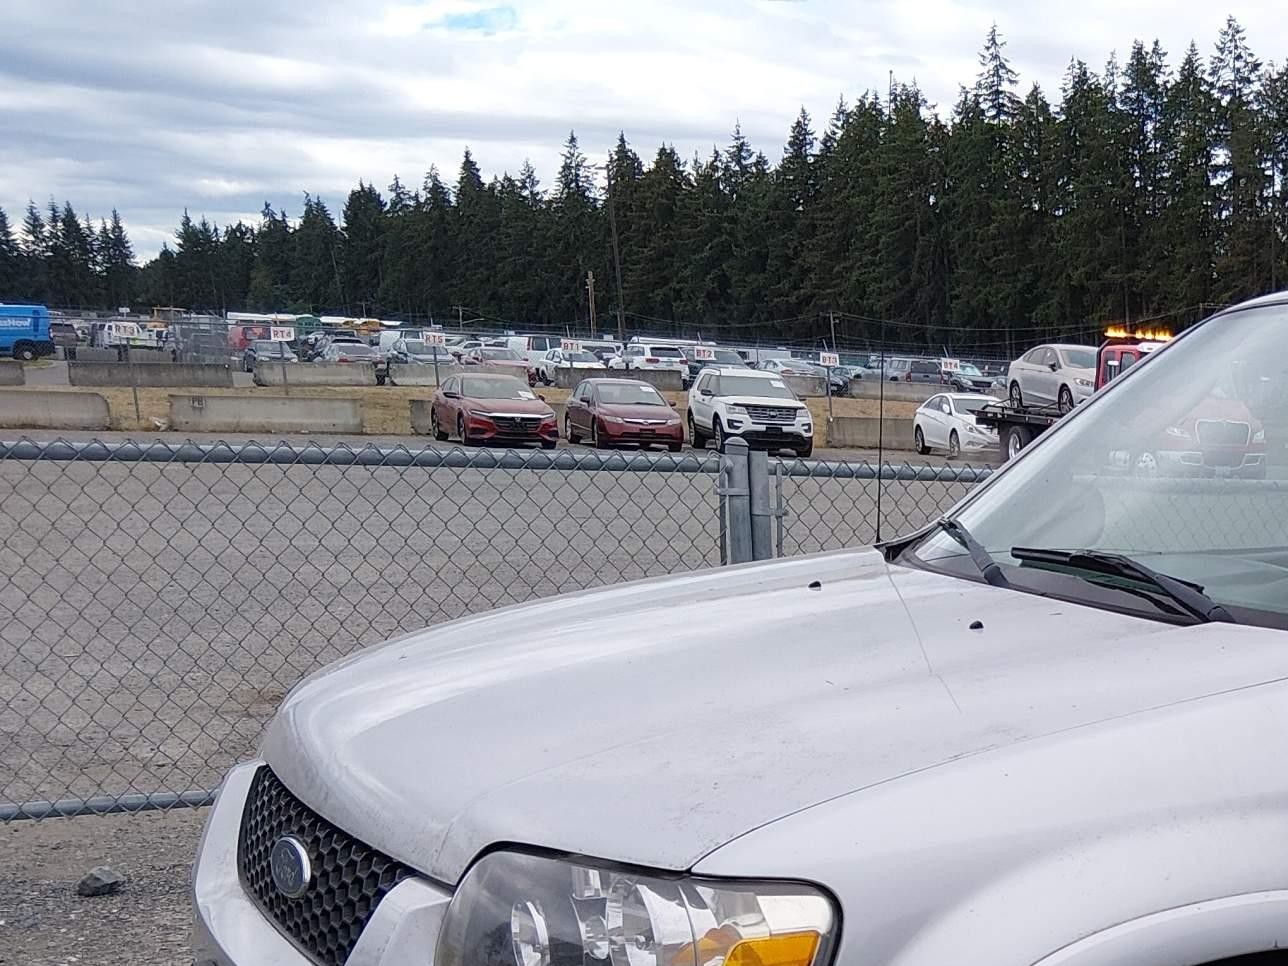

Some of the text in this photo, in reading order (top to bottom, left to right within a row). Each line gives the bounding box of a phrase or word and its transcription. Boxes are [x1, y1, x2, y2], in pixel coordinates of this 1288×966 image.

[114, 324, 136, 335] RT3
[272, 328, 292, 339] RT4
[425, 334, 443, 344] RT5
[563, 342, 580, 352] BT1
[696, 349, 713, 359] BT2
